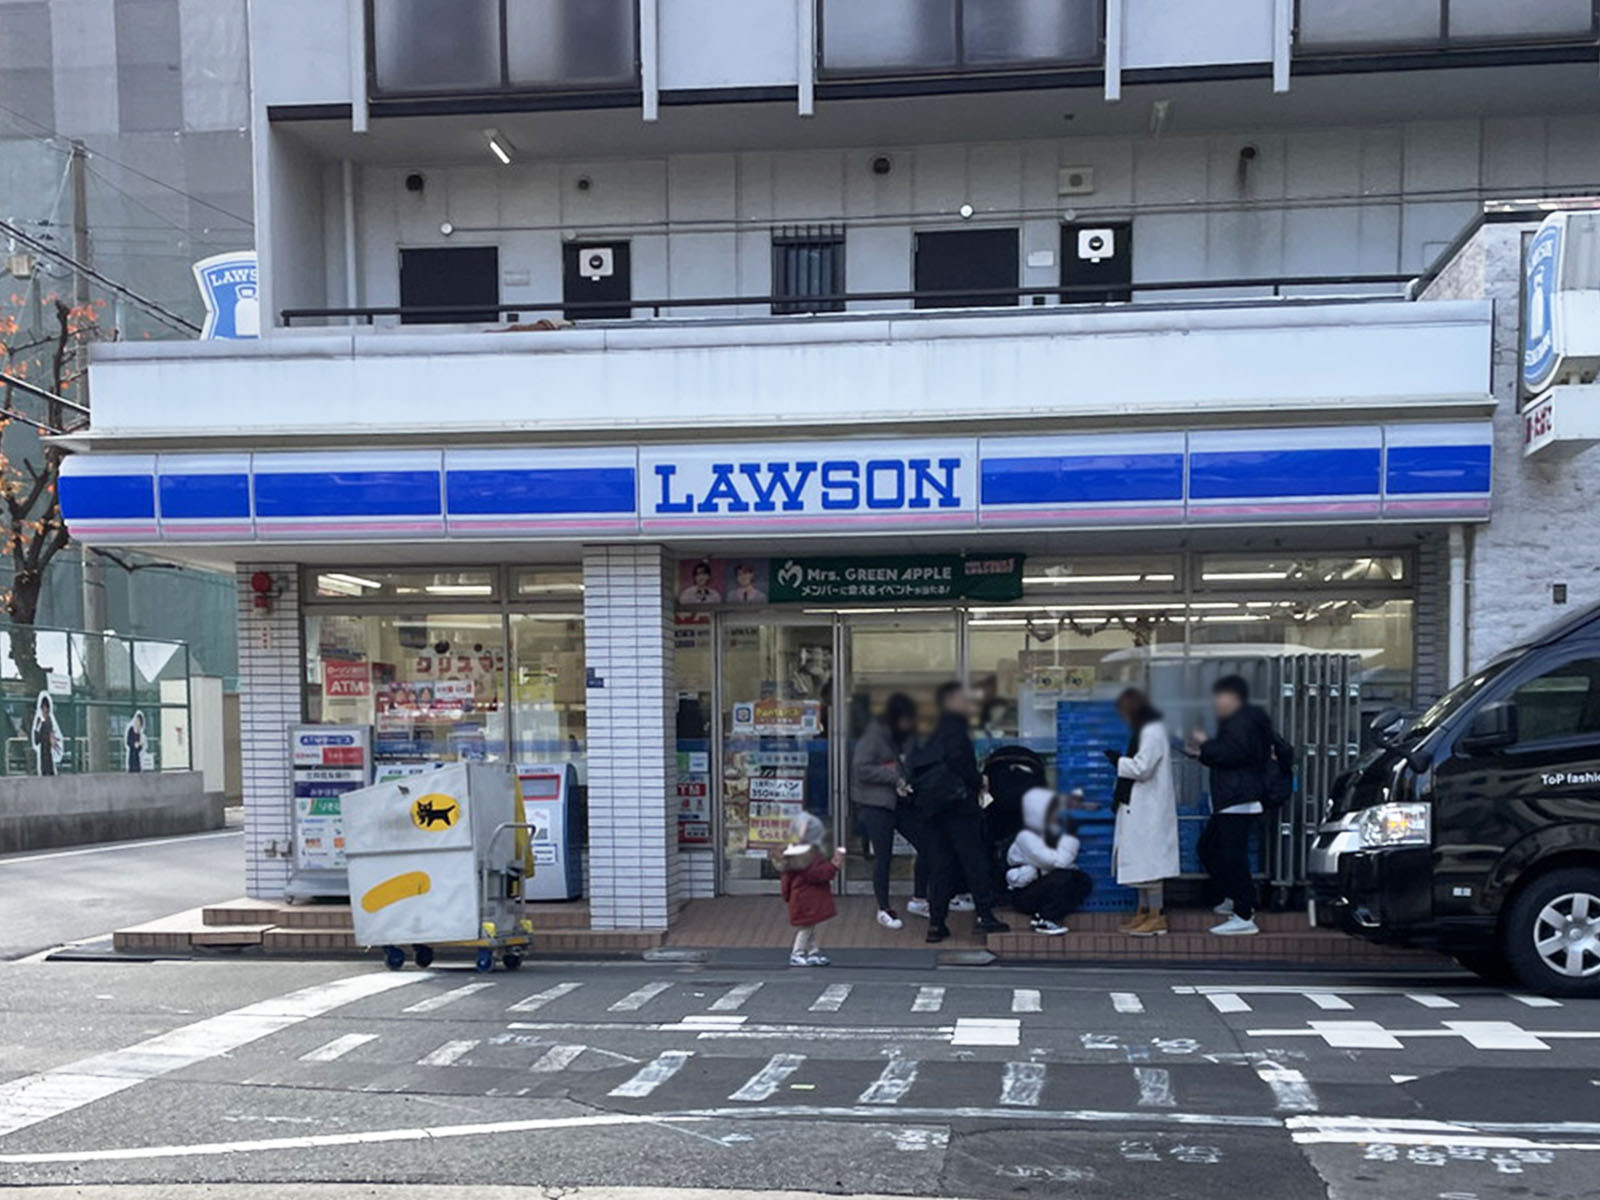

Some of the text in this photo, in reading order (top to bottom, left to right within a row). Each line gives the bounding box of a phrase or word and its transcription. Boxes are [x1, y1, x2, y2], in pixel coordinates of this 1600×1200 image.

[655, 458, 961, 513] LAWSON
[807, 568, 841, 581] Mrs.
[845, 567, 898, 581] GREEN
[901, 566, 953, 580] APPLE
[330, 680, 365, 694] ATM
